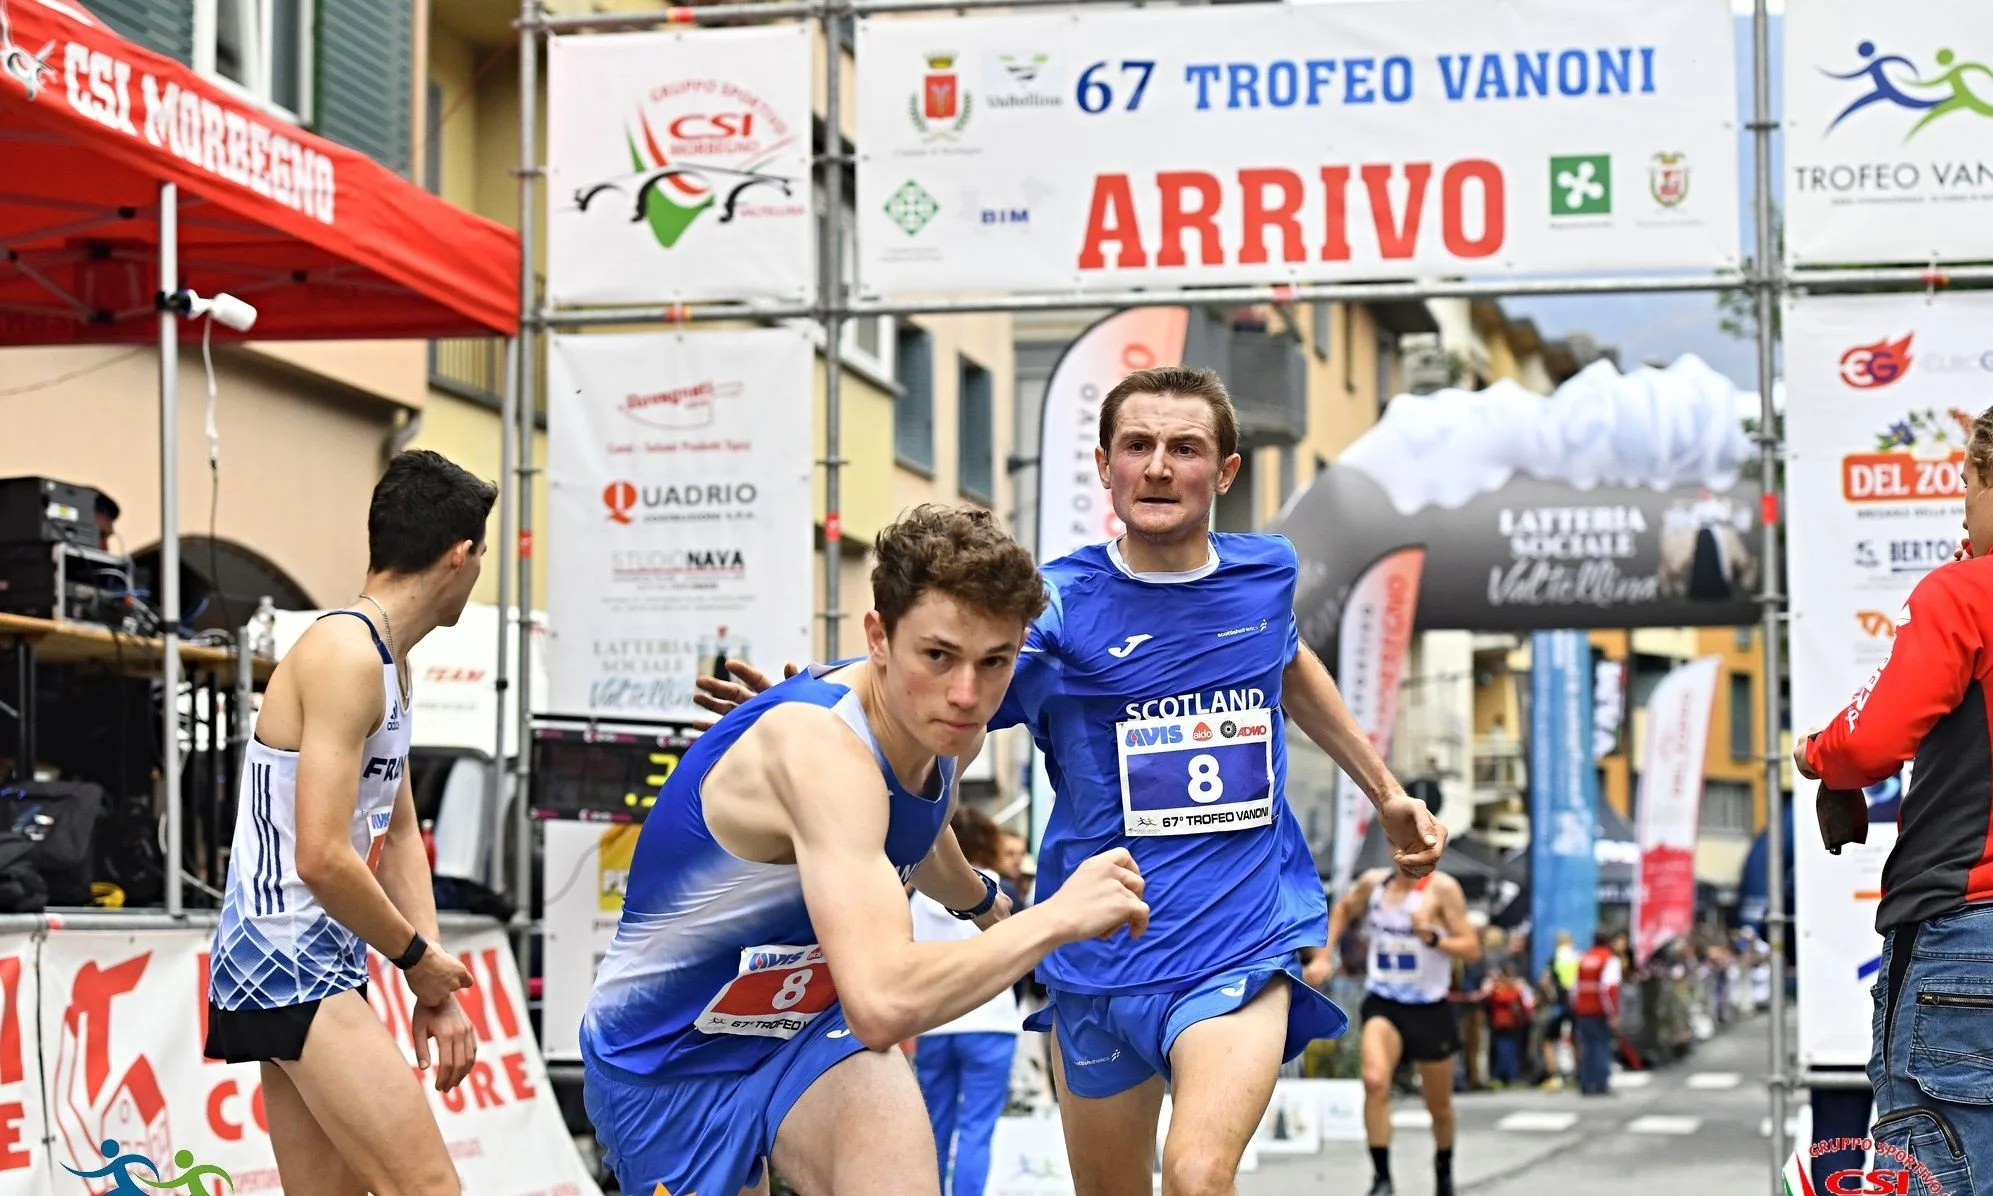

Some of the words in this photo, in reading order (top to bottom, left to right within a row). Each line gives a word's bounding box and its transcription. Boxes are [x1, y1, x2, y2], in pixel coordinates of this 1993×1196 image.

[1076, 60, 1156, 114] 67
[1185, 56, 1413, 111] TROFEO
[1437, 47, 1656, 101] VANONI
[64, 42, 138, 137] CSI
[142, 74, 335, 225] MORBEGNO
[668, 111, 753, 139] CSI
[1794, 162, 1921, 192] TROFEO
[981, 209, 1030, 224] BIM
[1077, 157, 1506, 271] ARRIVO
[1850, 463, 1910, 498] DEL
[602, 480, 758, 526] QUADRIO
[1498, 505, 1648, 534] LATTERIA
[1125, 688, 1265, 722] SCOTLAND
[1125, 724, 1184, 748] AVIS
[1193, 730, 1213, 740] aido
[1237, 725, 1267, 738] ADMO
[1187, 753, 1224, 804] 8
[1186, 811, 1236, 826] TROFEO
[1237, 806, 1269, 822] VANONI
[748, 951, 805, 971] AVIS
[771, 968, 814, 1010] 8
[755, 1018, 801, 1031] TROFEO
